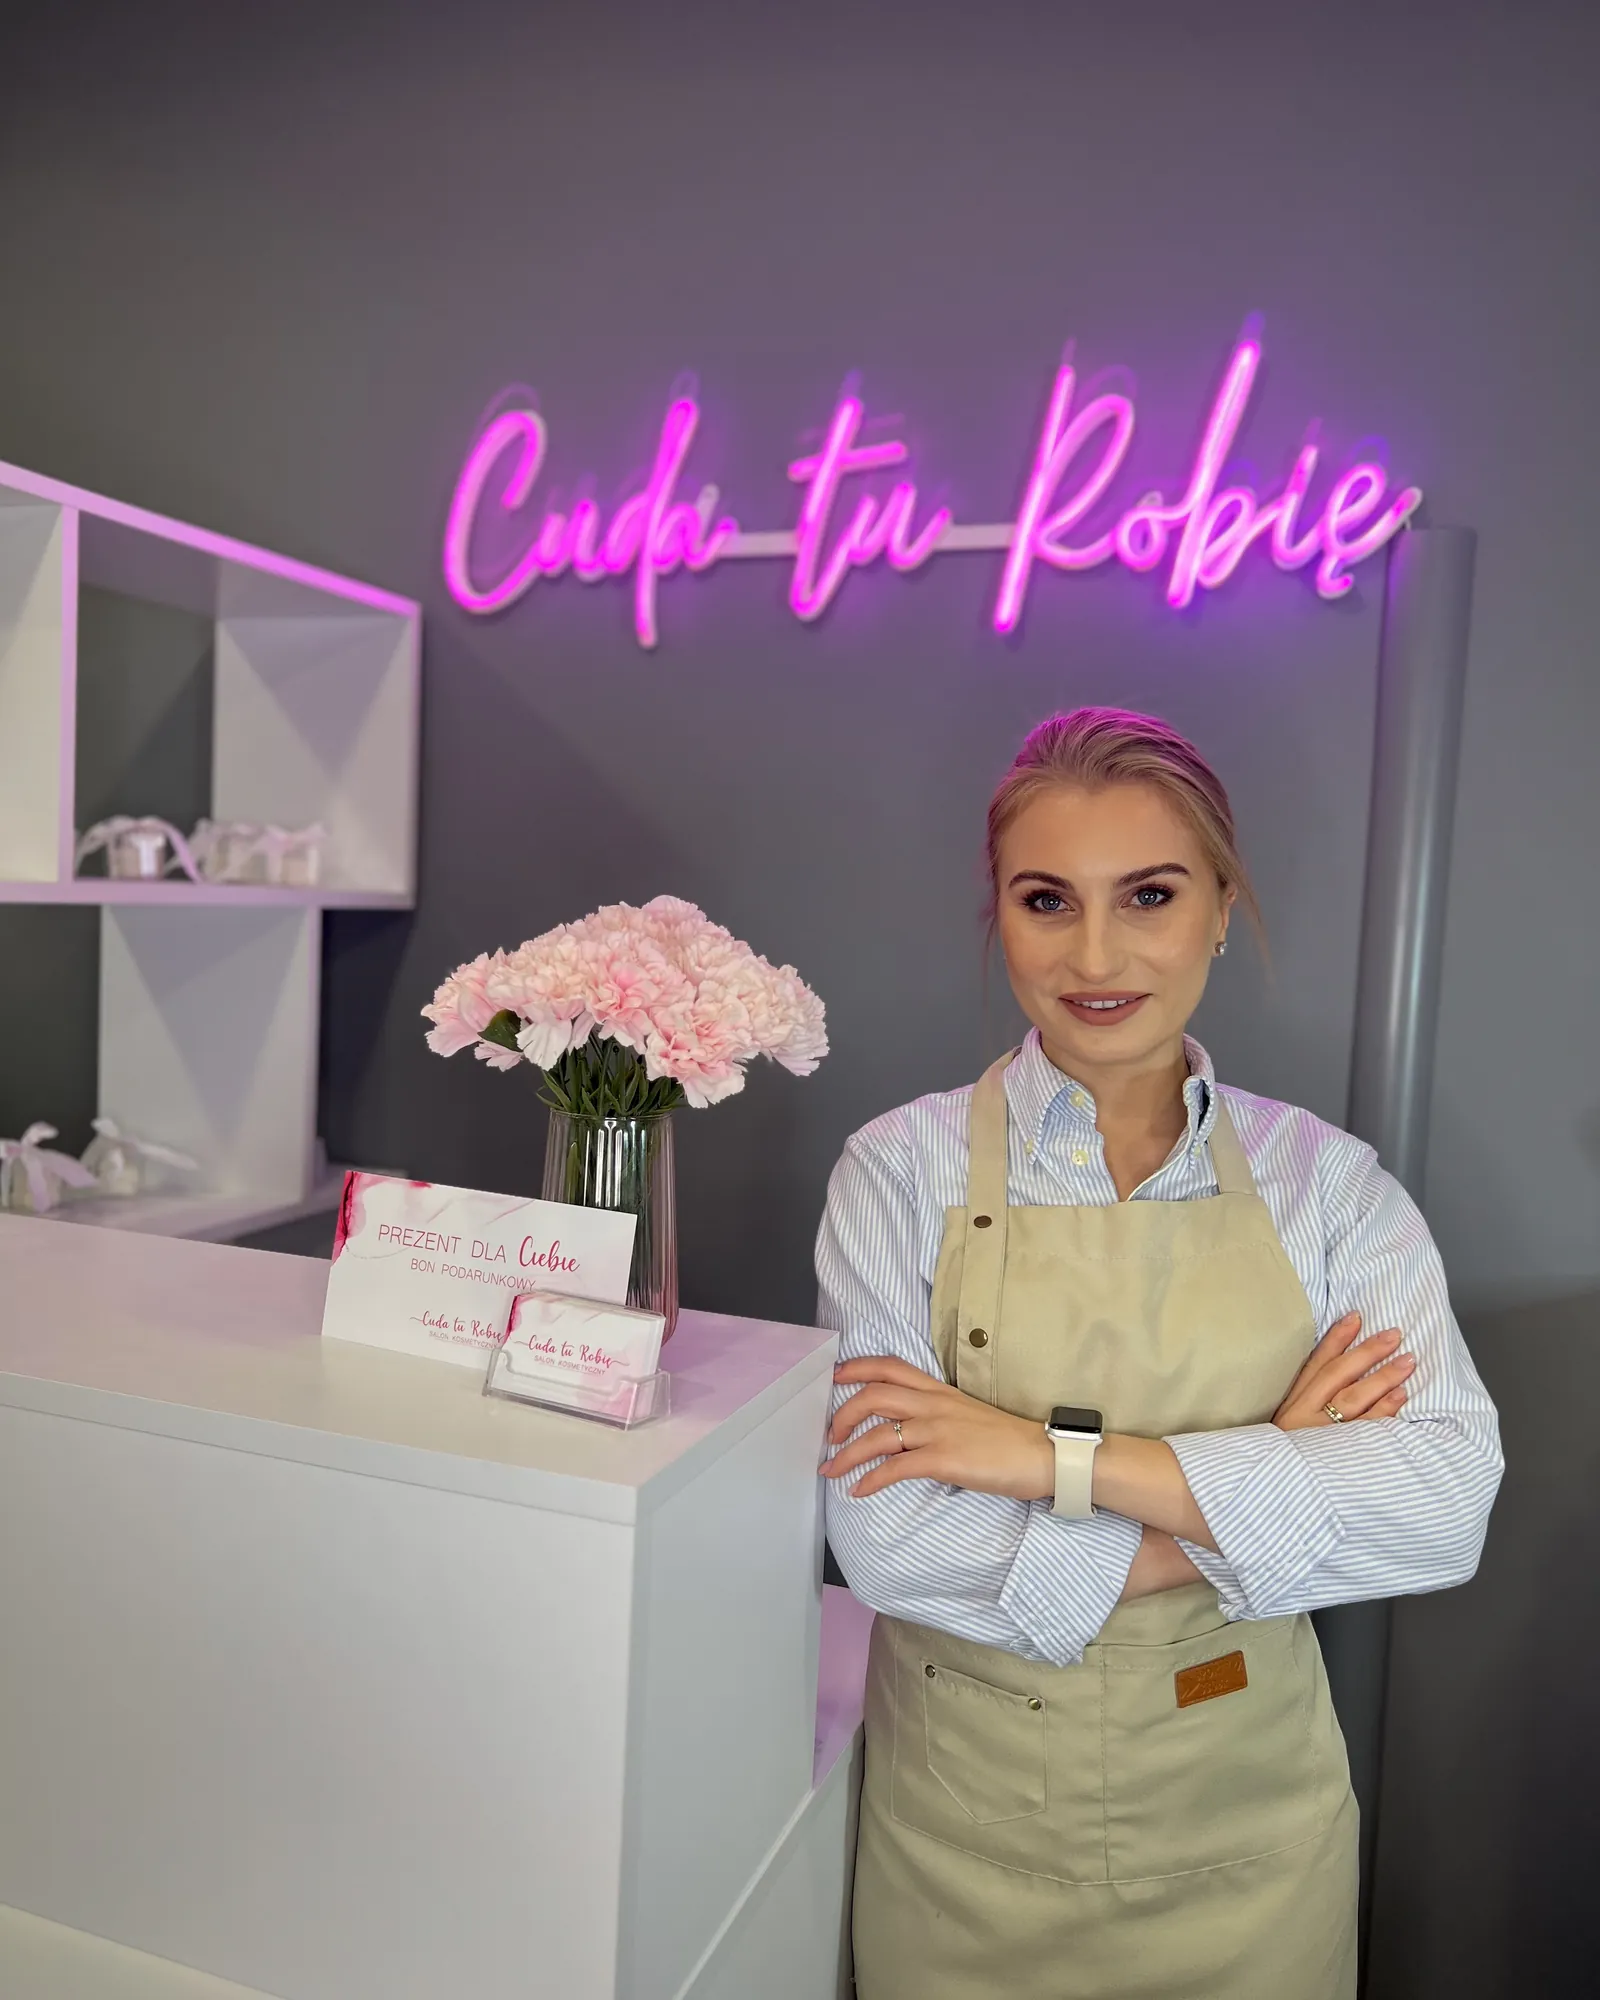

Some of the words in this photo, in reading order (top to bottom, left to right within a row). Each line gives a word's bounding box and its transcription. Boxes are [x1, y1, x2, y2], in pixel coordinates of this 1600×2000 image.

[443, 396, 739, 648] Cuda
[788, 396, 953, 622] tu
[993, 338, 1424, 634] Robię
[378, 1224, 461, 1255] PREZENT
[471, 1240, 507, 1264] DLA
[519, 1235, 581, 1273] Ciebie
[410, 1258, 436, 1274] BON
[441, 1263, 536, 1292] PODARUNKOWY
[409, 1310, 450, 1329] Cuda
[453, 1316, 466, 1333] tu
[428, 1330, 449, 1341] SALON
[451, 1335, 498, 1350] KOSMETYCZNY
[514, 1334, 557, 1354] Cuda
[561, 1340, 575, 1357] tu
[533, 1354, 555, 1366] SALON
[557, 1361, 606, 1376] KOSMETYCZNY
